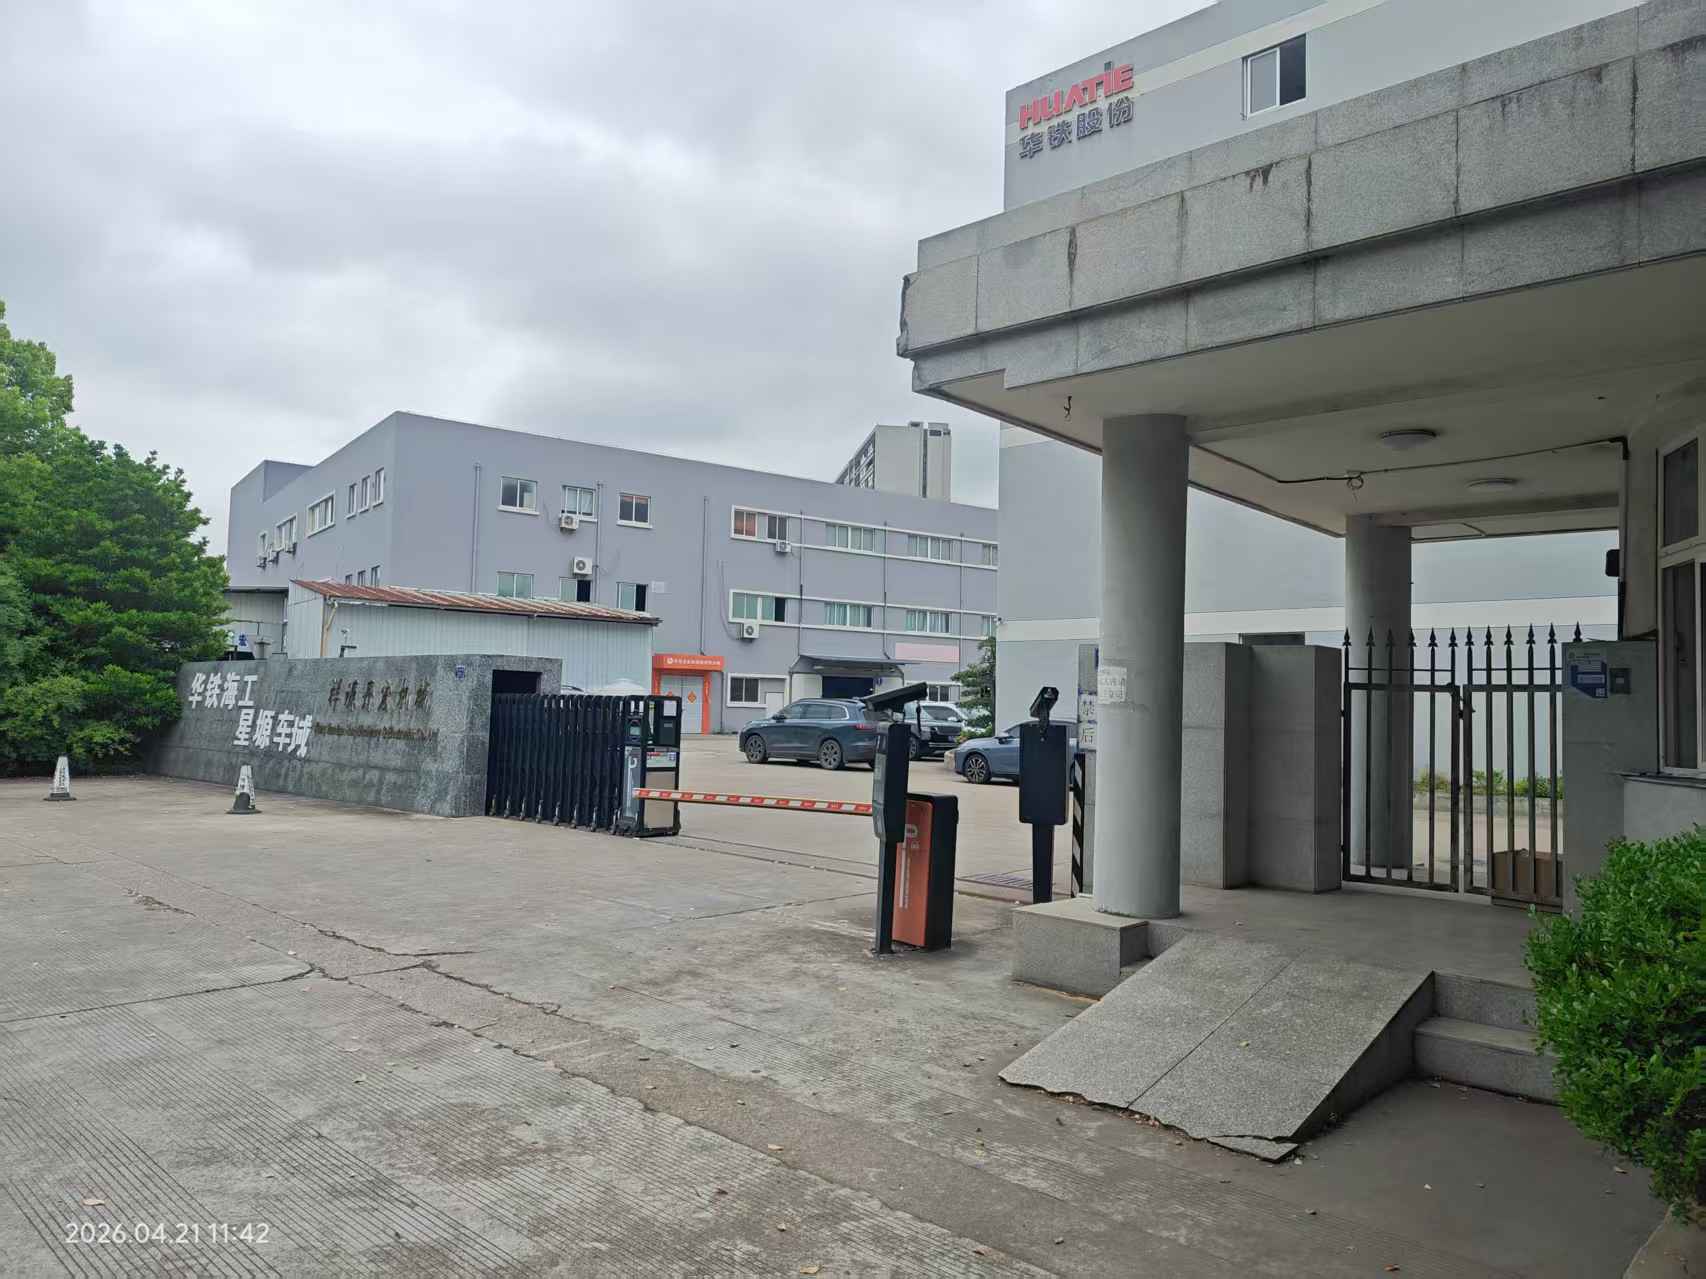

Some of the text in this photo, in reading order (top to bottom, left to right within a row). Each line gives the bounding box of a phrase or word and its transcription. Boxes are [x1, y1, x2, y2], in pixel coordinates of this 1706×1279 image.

[1019, 64, 1134, 129] HUATIE
[188, 672, 258, 710] 华铁海工
